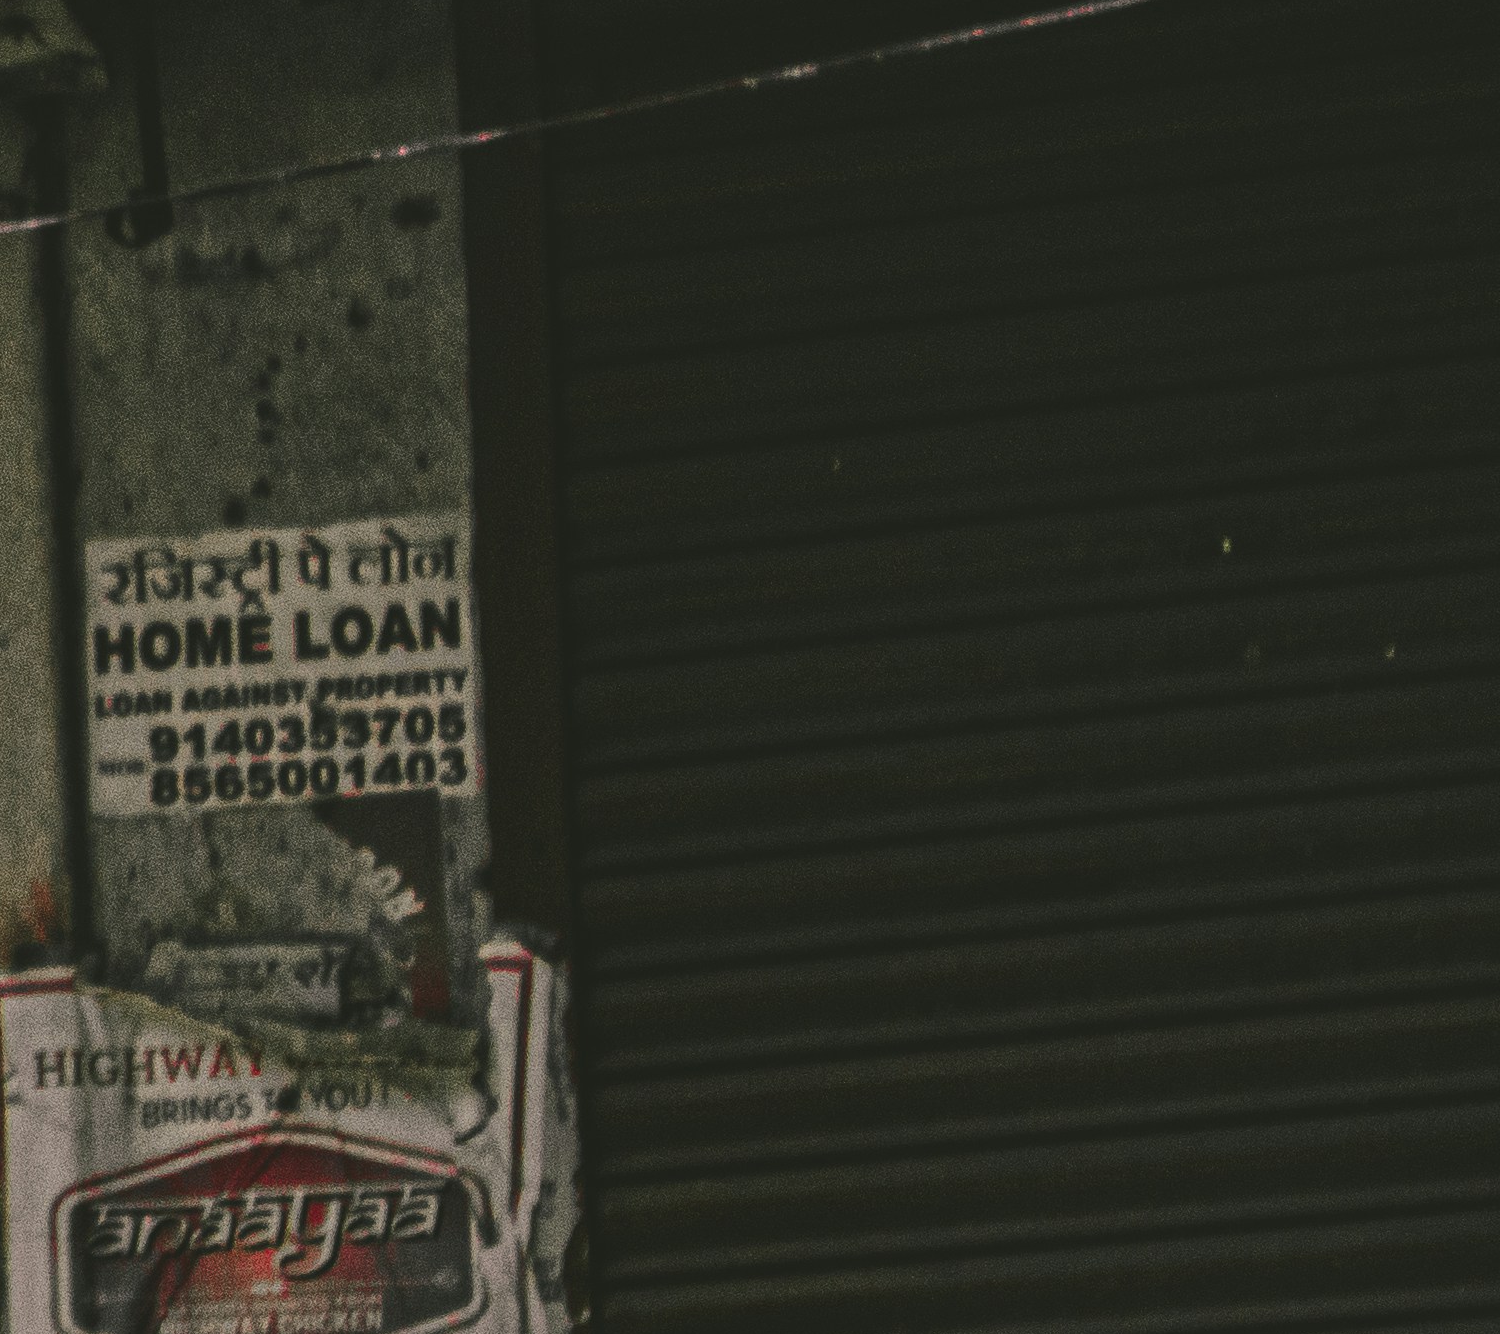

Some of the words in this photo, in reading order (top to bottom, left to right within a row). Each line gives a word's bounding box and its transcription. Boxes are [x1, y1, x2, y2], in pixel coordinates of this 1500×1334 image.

[298, 529, 330, 590] पे
[348, 527, 456, 587] लोन
[94, 616, 274, 675] HOME
[294, 597, 461, 661] LOAN
[96, 690, 171, 718] LOAN
[183, 678, 306, 712] AGAINST
[317, 668, 469, 702] PROPERTY
[33, 1041, 266, 1090] HIGHWAY
[141, 1092, 252, 1129] BRINGS
